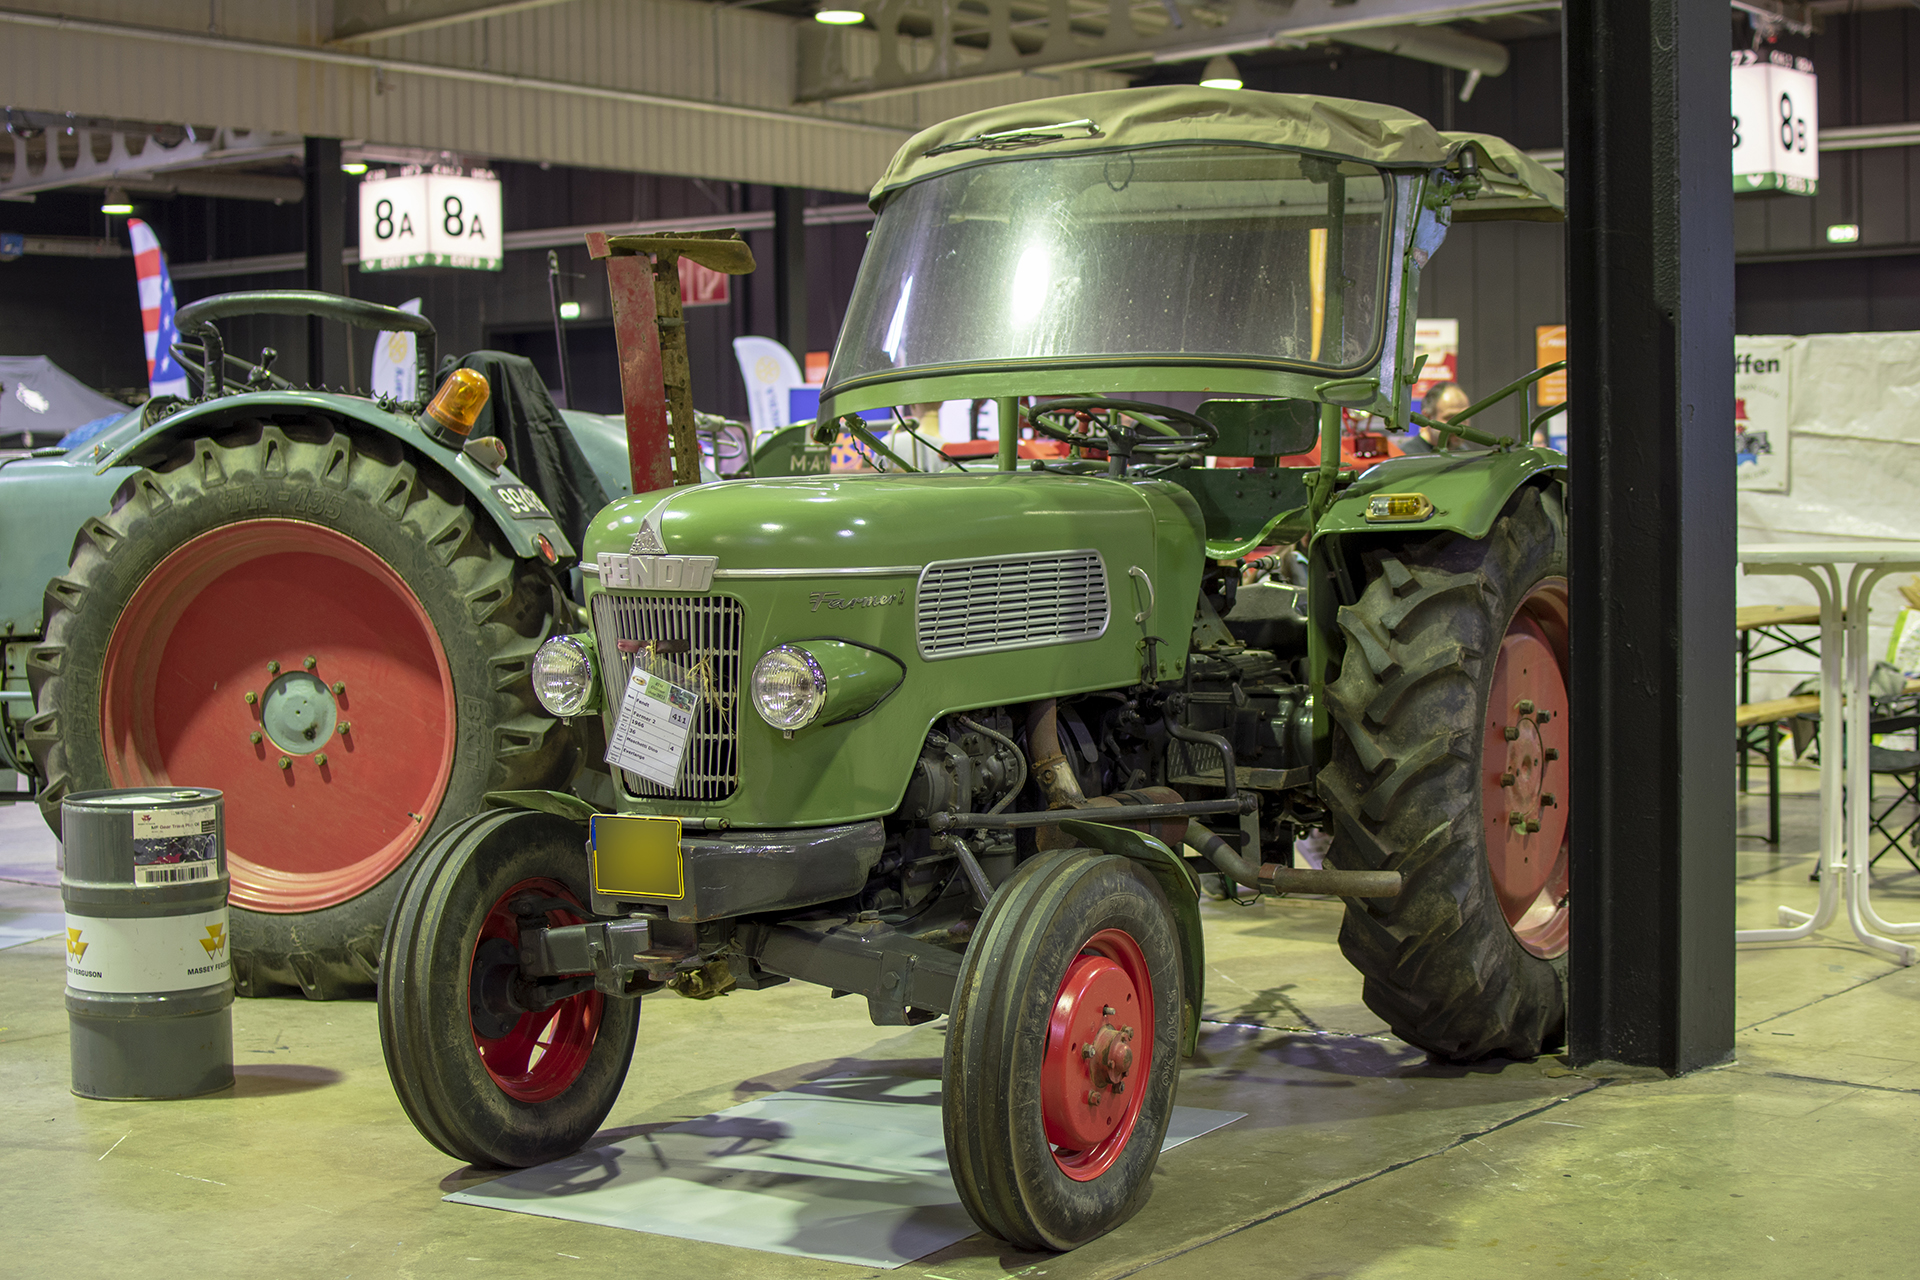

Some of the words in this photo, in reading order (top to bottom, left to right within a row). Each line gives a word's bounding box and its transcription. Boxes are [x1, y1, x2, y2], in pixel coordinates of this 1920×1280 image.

[374, 198, 414, 239] 8A
[443, 195, 486, 239] 8A
[600, 556, 715, 590] FENDT
[809, 591, 897, 612] Farmer
[636, 698, 650, 708] Fendt
[633, 711, 651, 722] Farmer
[672, 713, 687, 724] 411
[187, 964, 214, 975] MASSEY
